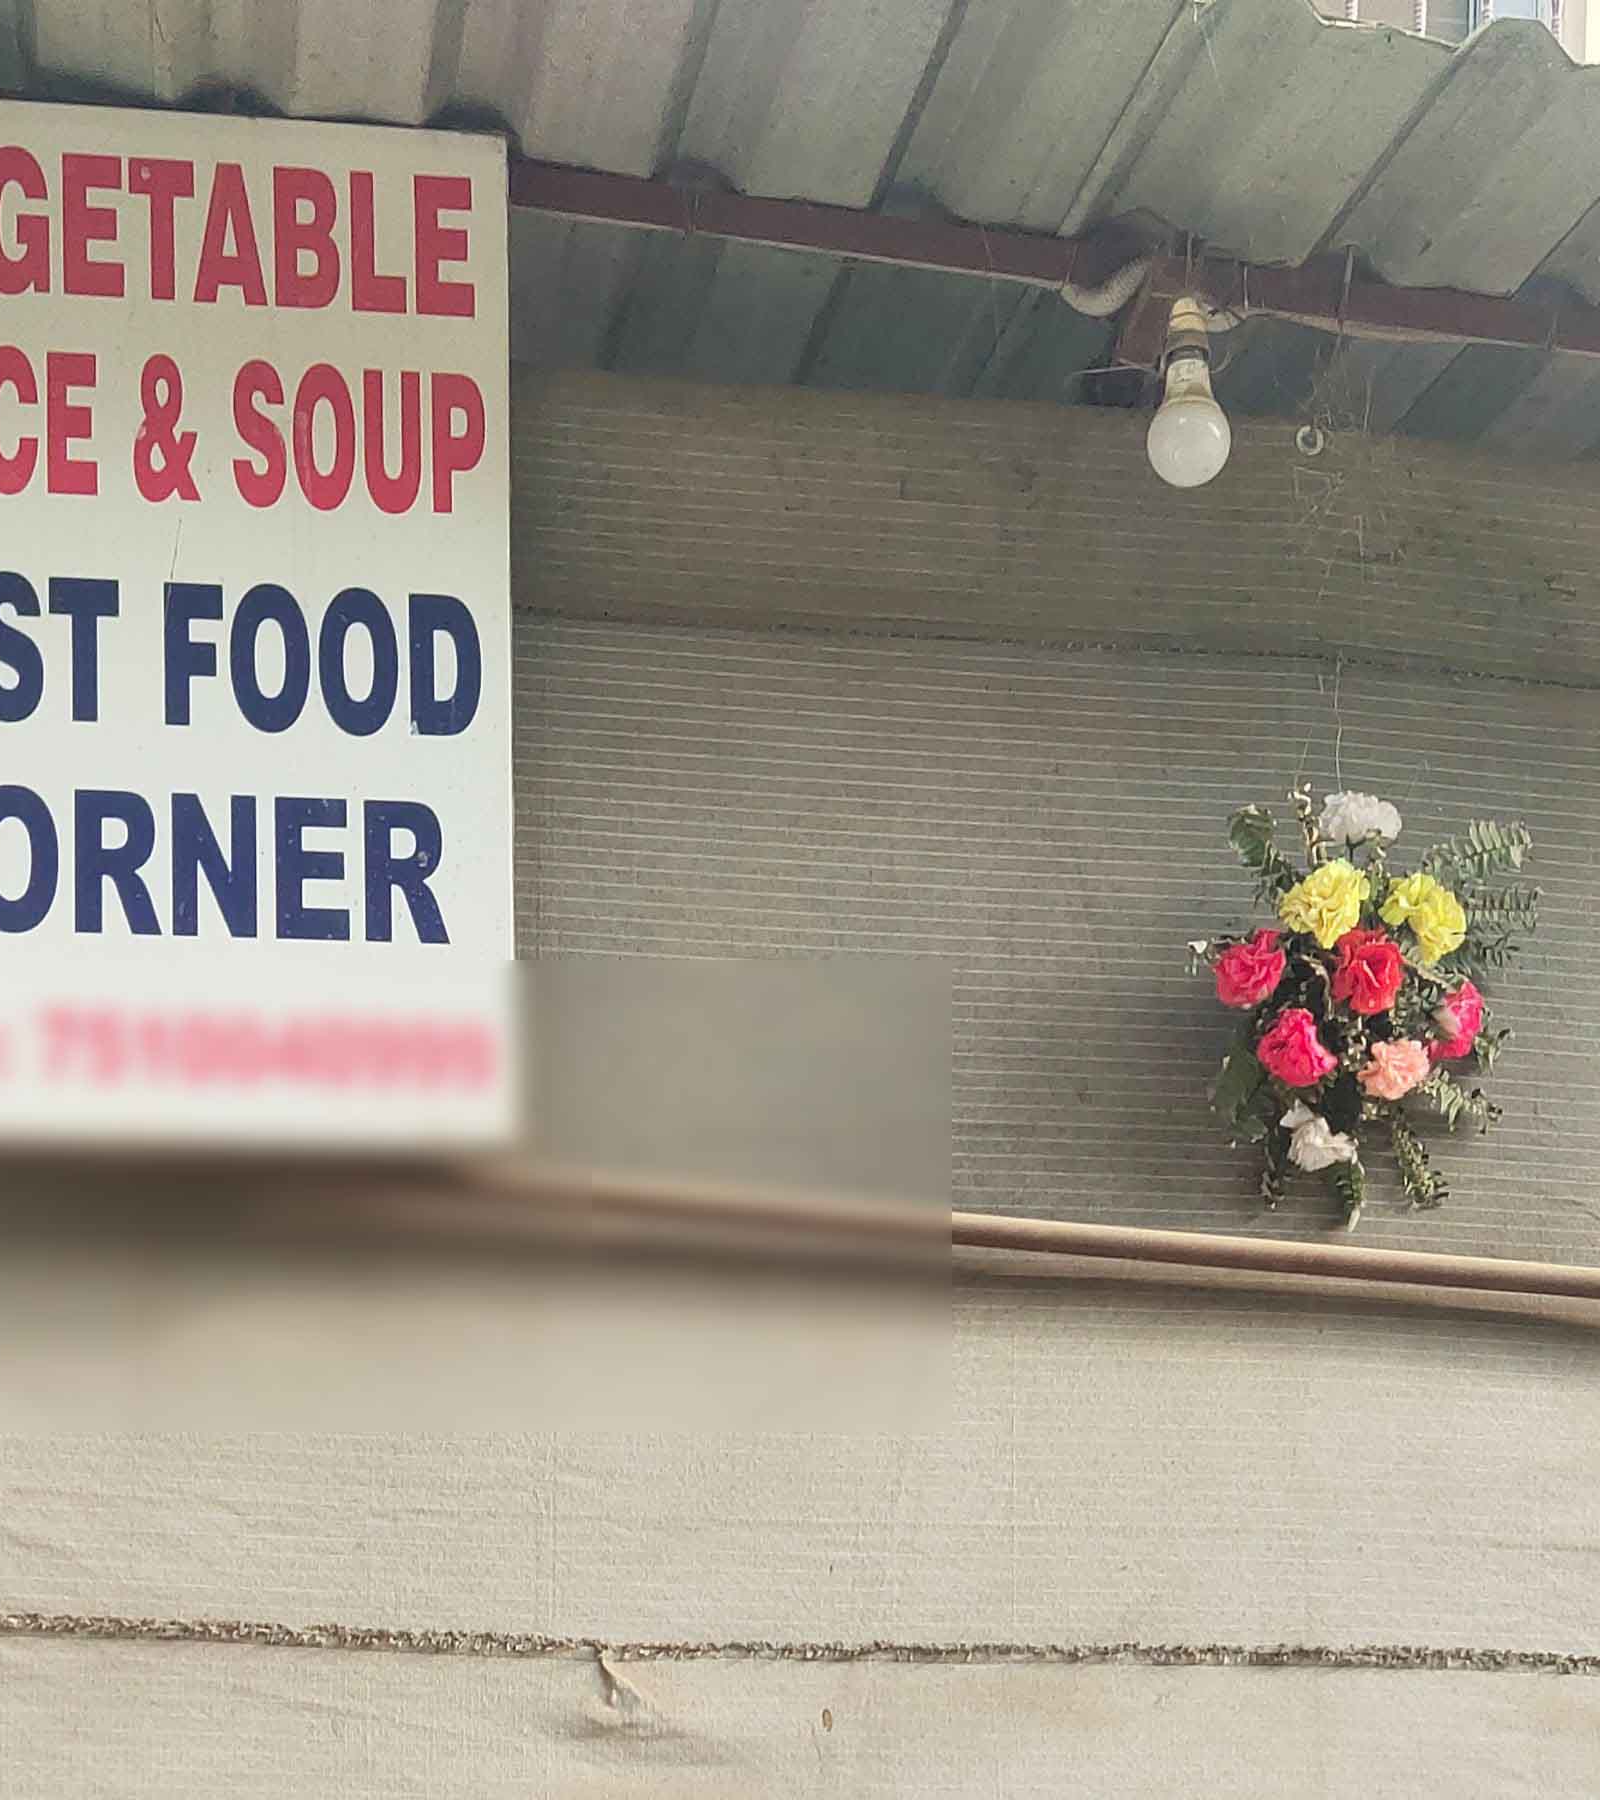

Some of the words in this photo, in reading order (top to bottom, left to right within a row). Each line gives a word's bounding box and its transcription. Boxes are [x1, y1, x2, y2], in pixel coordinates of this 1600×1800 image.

[133, 353, 200, 502] &
[232, 360, 486, 514] SOUP
[163, 582, 483, 737] FOOD
